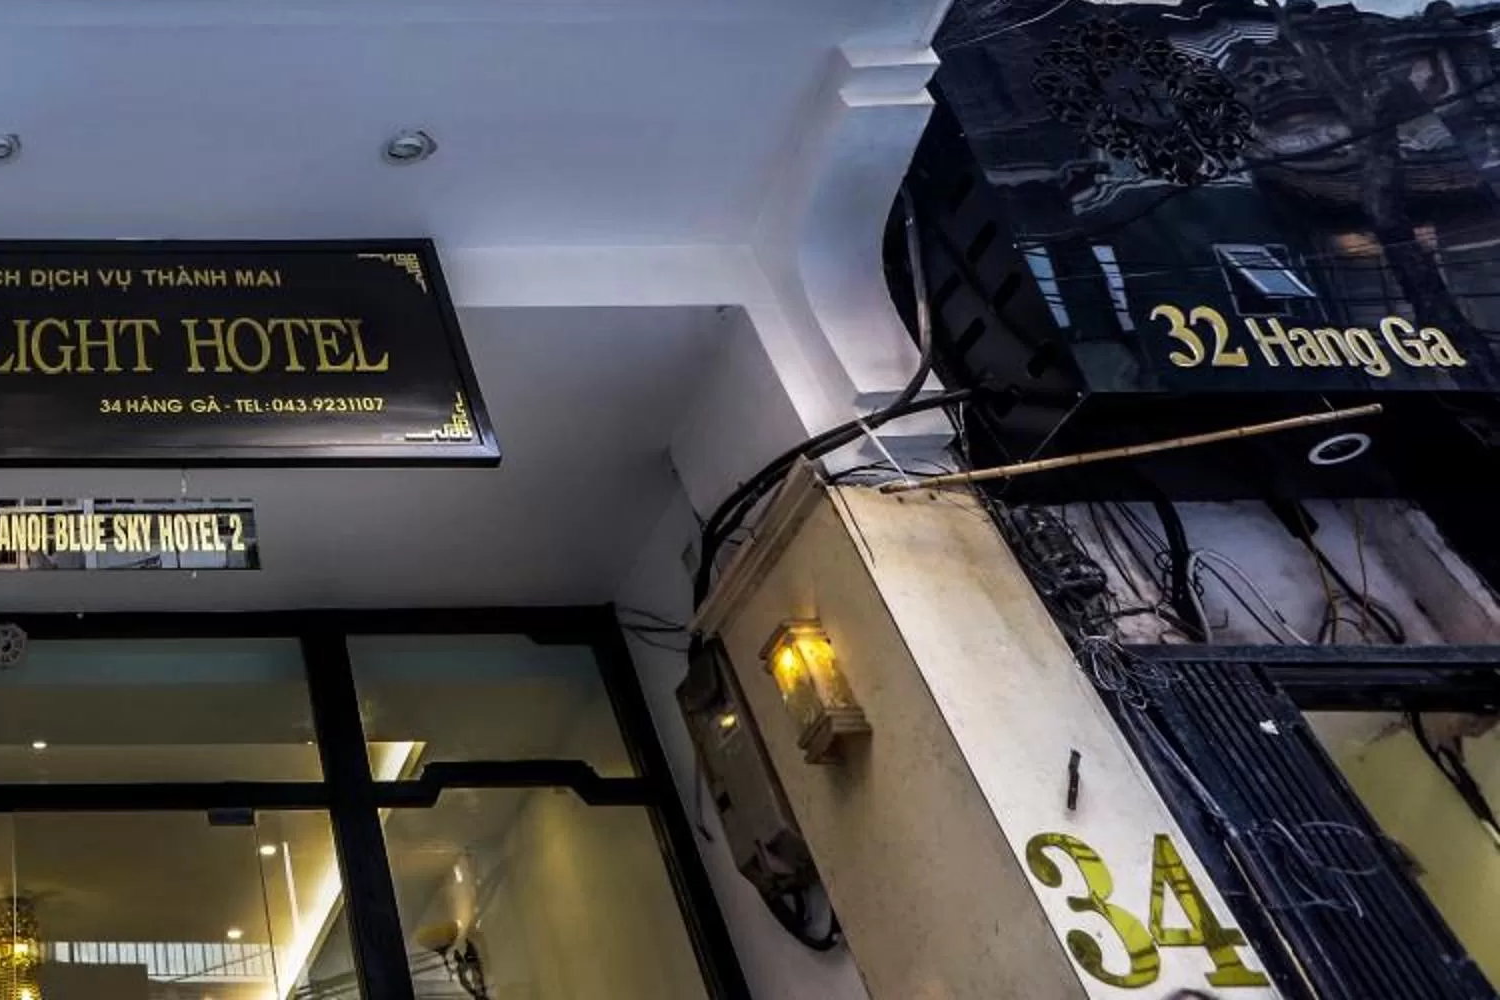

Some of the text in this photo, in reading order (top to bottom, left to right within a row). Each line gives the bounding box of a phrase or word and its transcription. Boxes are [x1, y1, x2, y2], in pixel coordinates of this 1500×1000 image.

[30, 269, 89, 292] DỊCH
[97, 268, 132, 292] VỤ
[141, 265, 227, 287] THÀNH
[235, 268, 281, 287] MAI
[181, 316, 389, 373] HOTEL
[1149, 305, 1467, 378] 32 Hang Ga
[100, 399, 121, 413] 34
[127, 395, 184, 413] HÀNG
[190, 395, 220, 413] GÀ
[54, 512, 107, 551] BLUE
[113, 512, 152, 551] SKY
[157, 512, 226, 551] HOTEL
[229, 512, 246, 551] 2
[1025, 832, 1271, 989] 34
